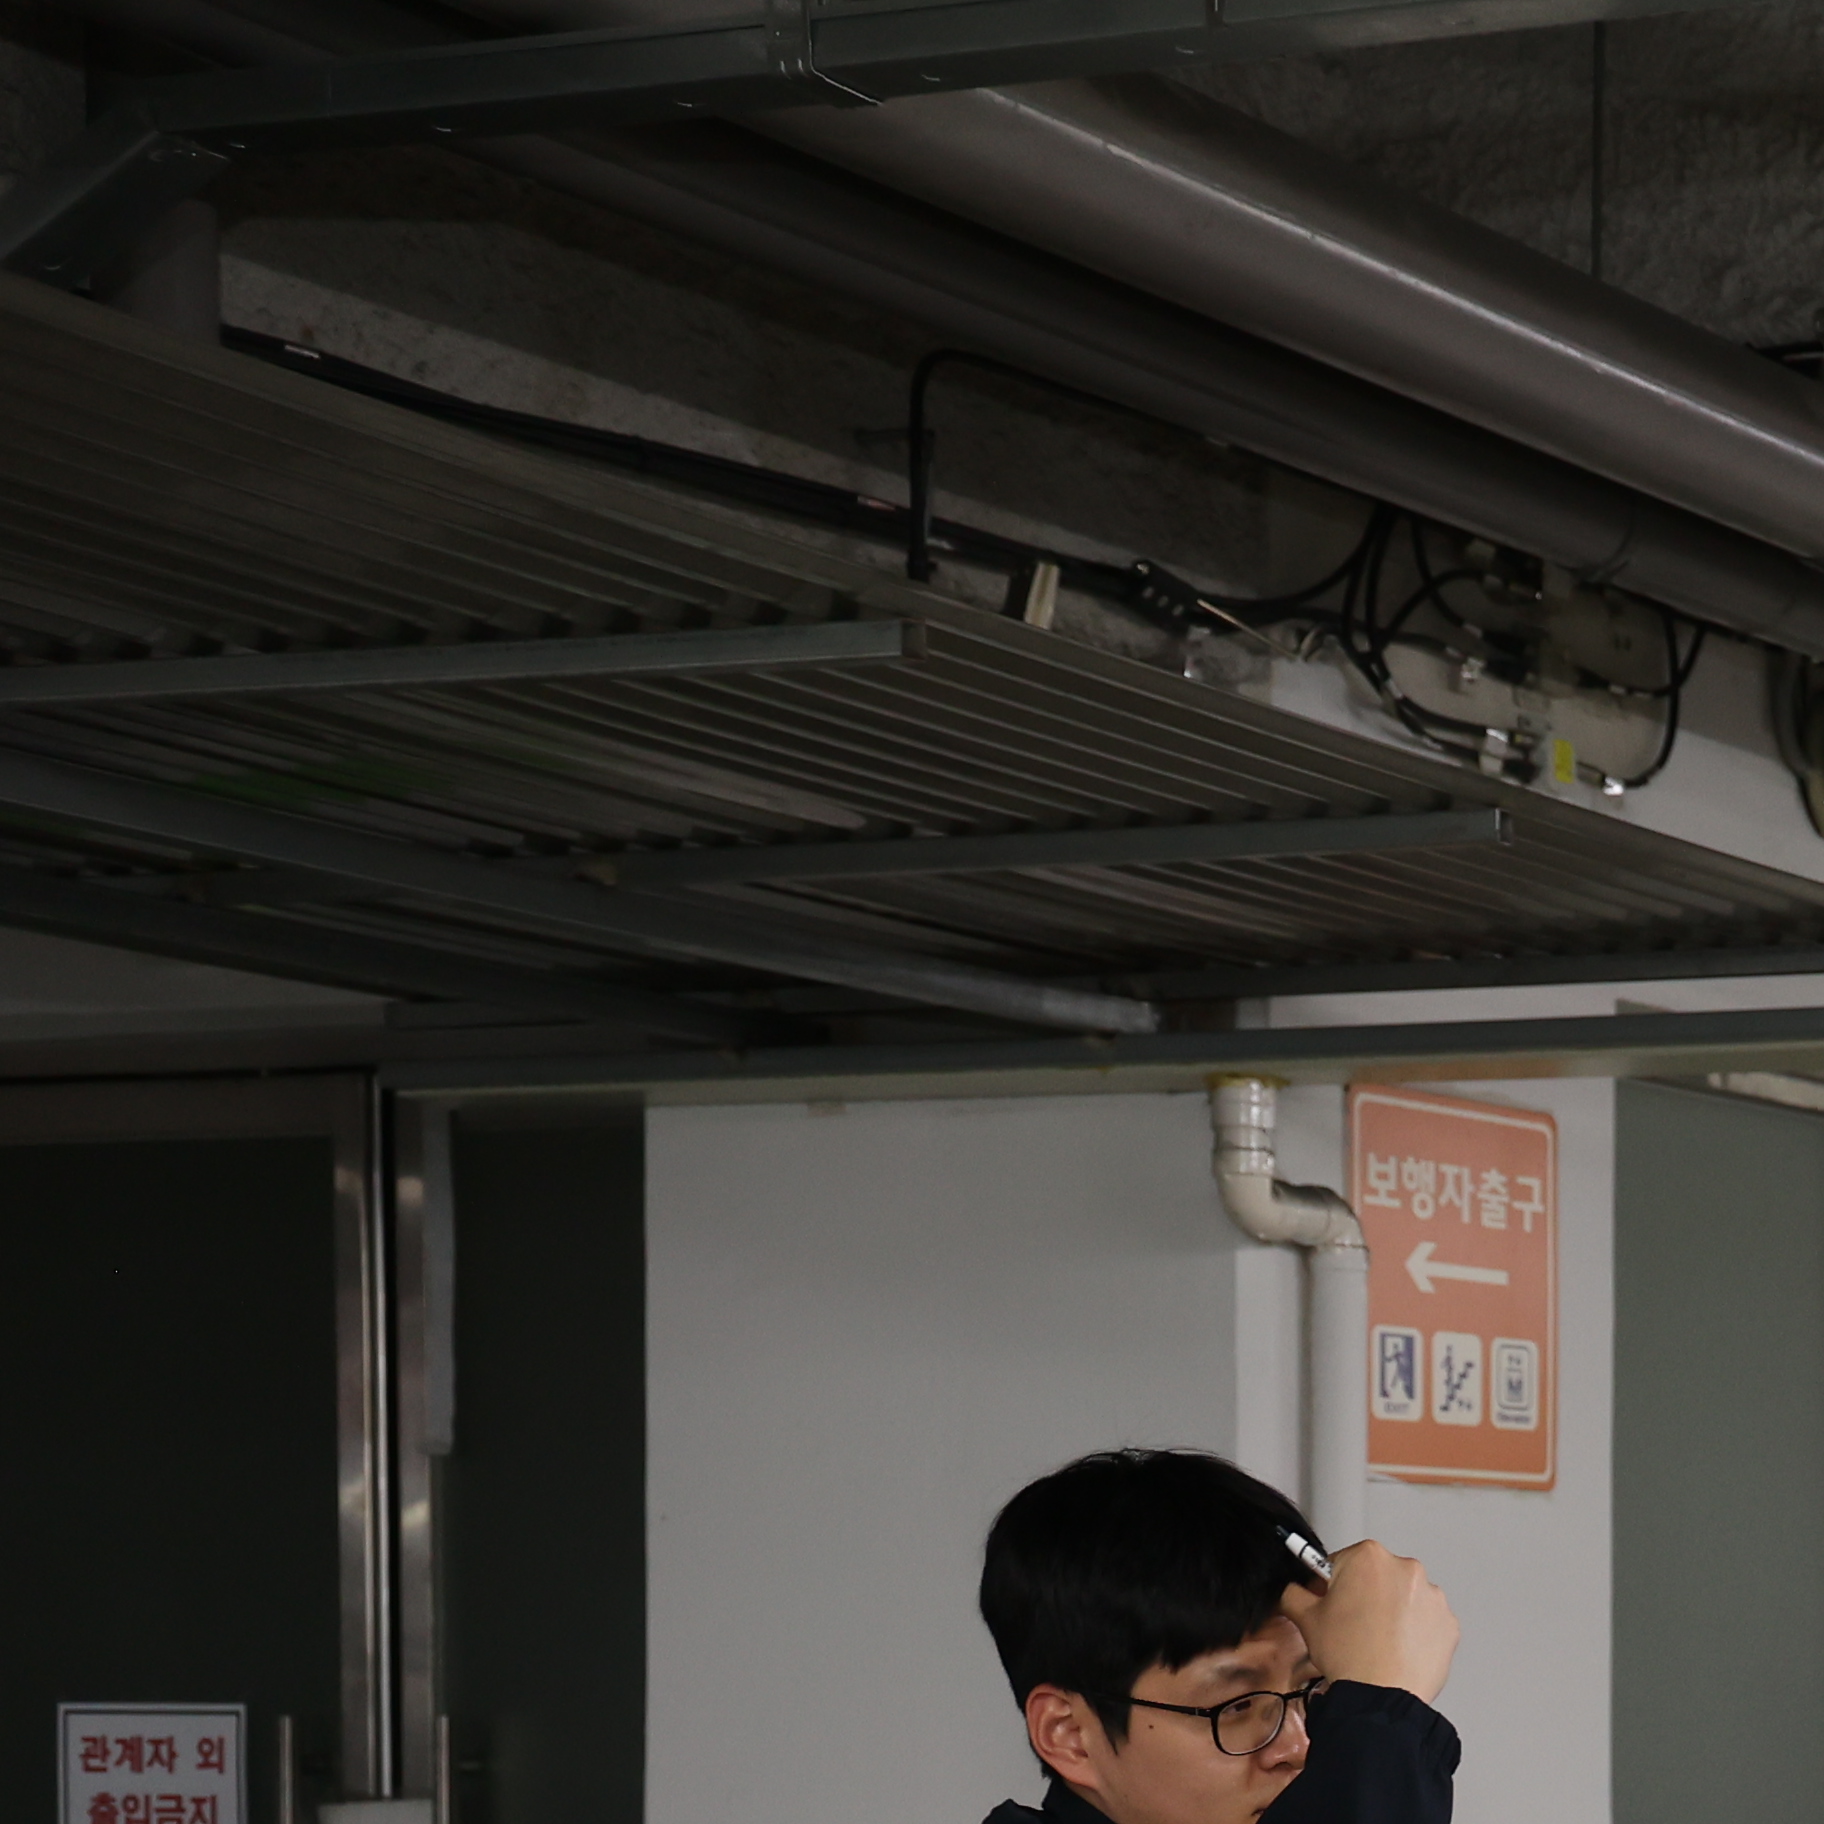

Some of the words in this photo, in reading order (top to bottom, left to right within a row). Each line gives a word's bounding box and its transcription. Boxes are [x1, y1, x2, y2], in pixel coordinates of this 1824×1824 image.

[1363, 1152, 1546, 1233] 보행자출구
[79, 1734, 179, 1774] 관계자
[195, 1735, 226, 1775] 외
